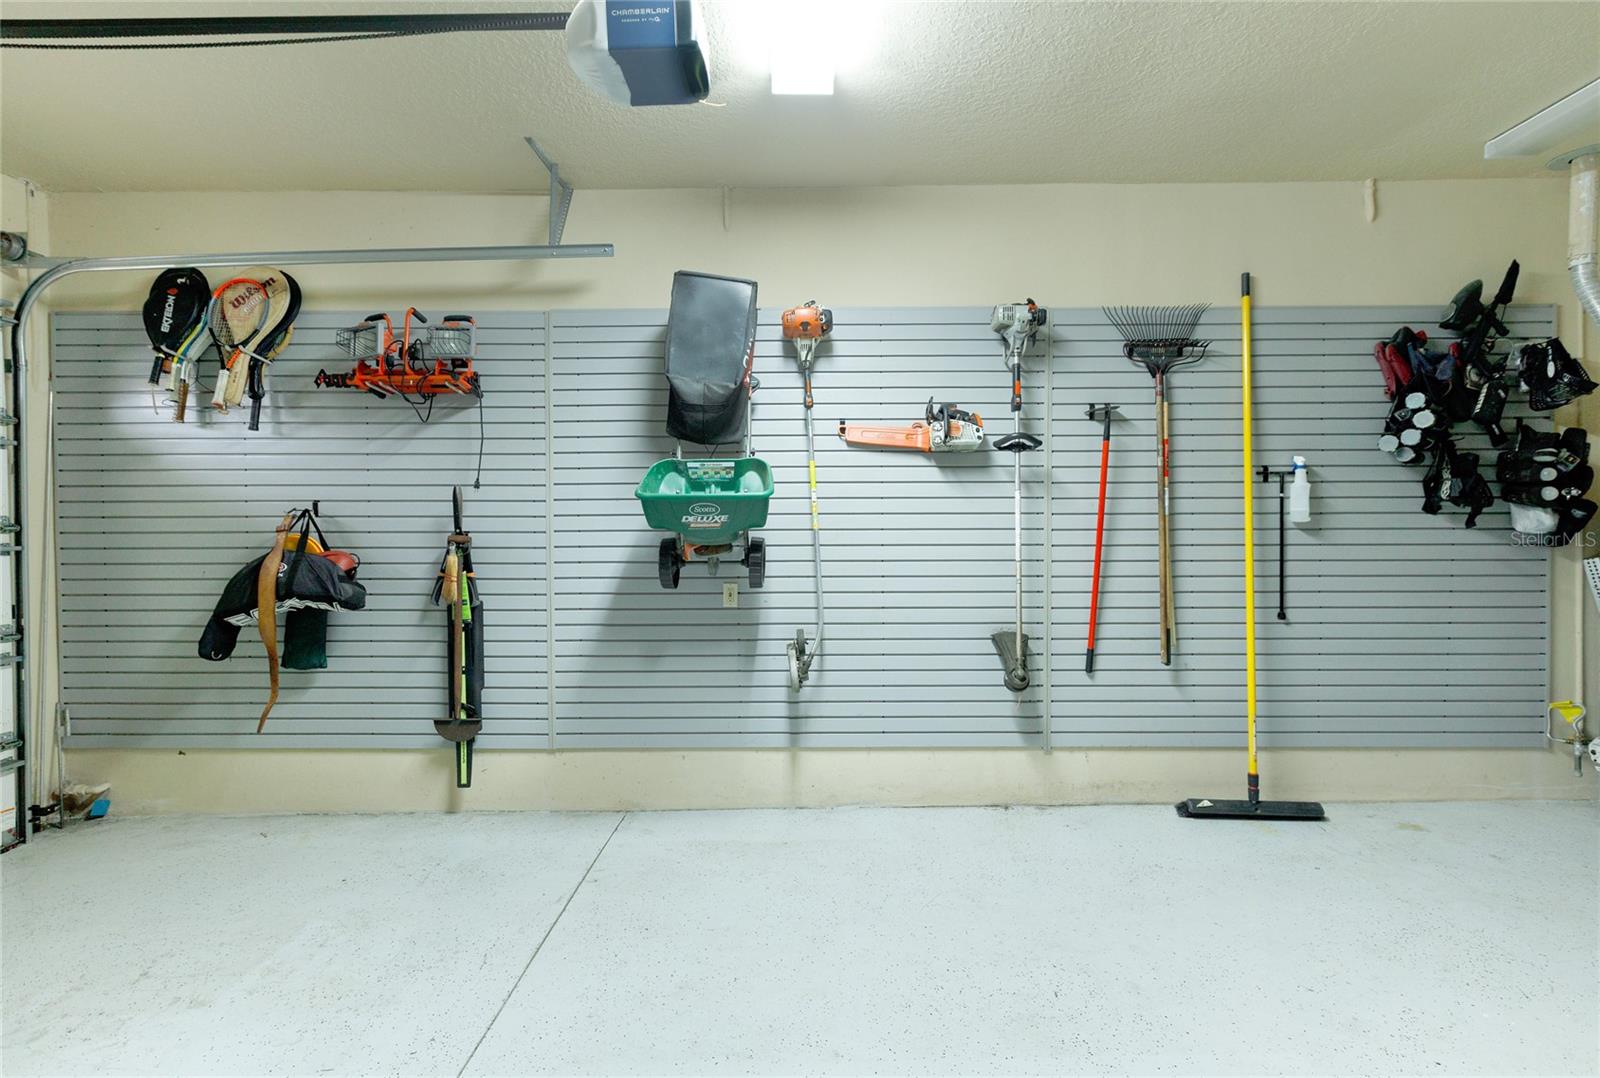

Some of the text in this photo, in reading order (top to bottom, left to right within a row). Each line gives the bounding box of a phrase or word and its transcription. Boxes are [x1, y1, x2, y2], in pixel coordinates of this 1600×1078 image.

[611, 7, 671, 17] CHAMBERLAIN
[161, 294, 176, 334] EKTELON
[681, 514, 730, 524] DELUXE
